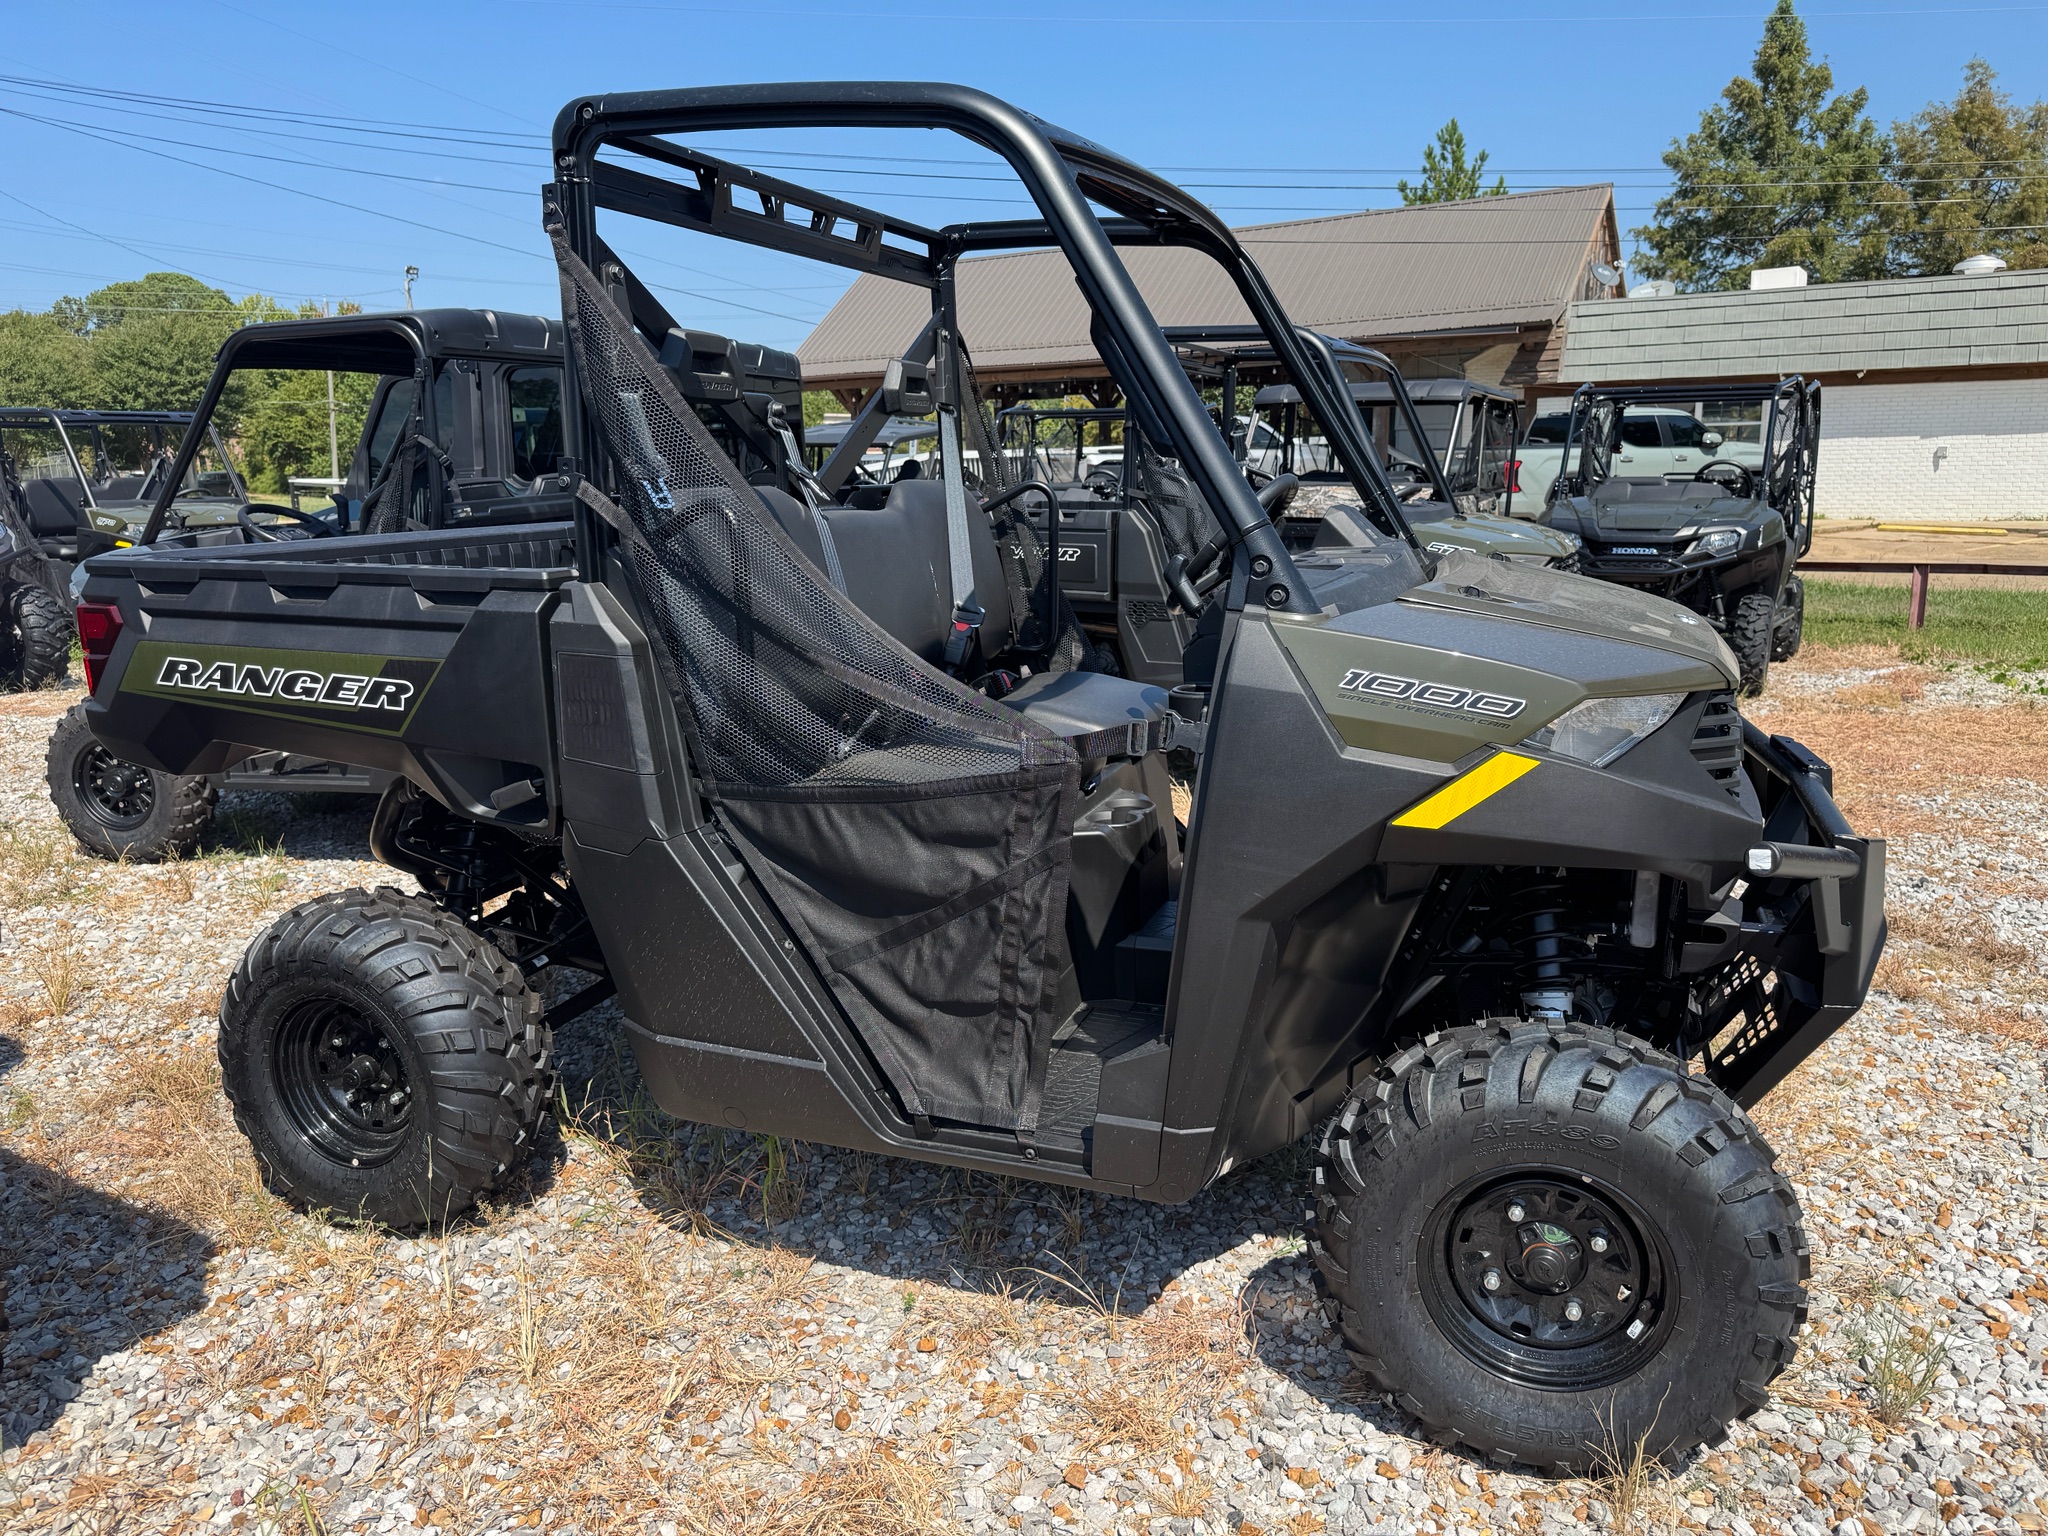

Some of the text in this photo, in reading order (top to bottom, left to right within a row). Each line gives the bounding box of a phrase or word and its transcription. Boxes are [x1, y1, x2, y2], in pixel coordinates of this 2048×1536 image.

[1611, 547, 1659, 555] HONDA
[156, 656, 414, 711] RANGER
[1338, 668, 1528, 720] 1000
[1335, 692, 1512, 730] SINGLE OVERHEAD CAM
[1471, 1118, 1621, 1150] AT489
